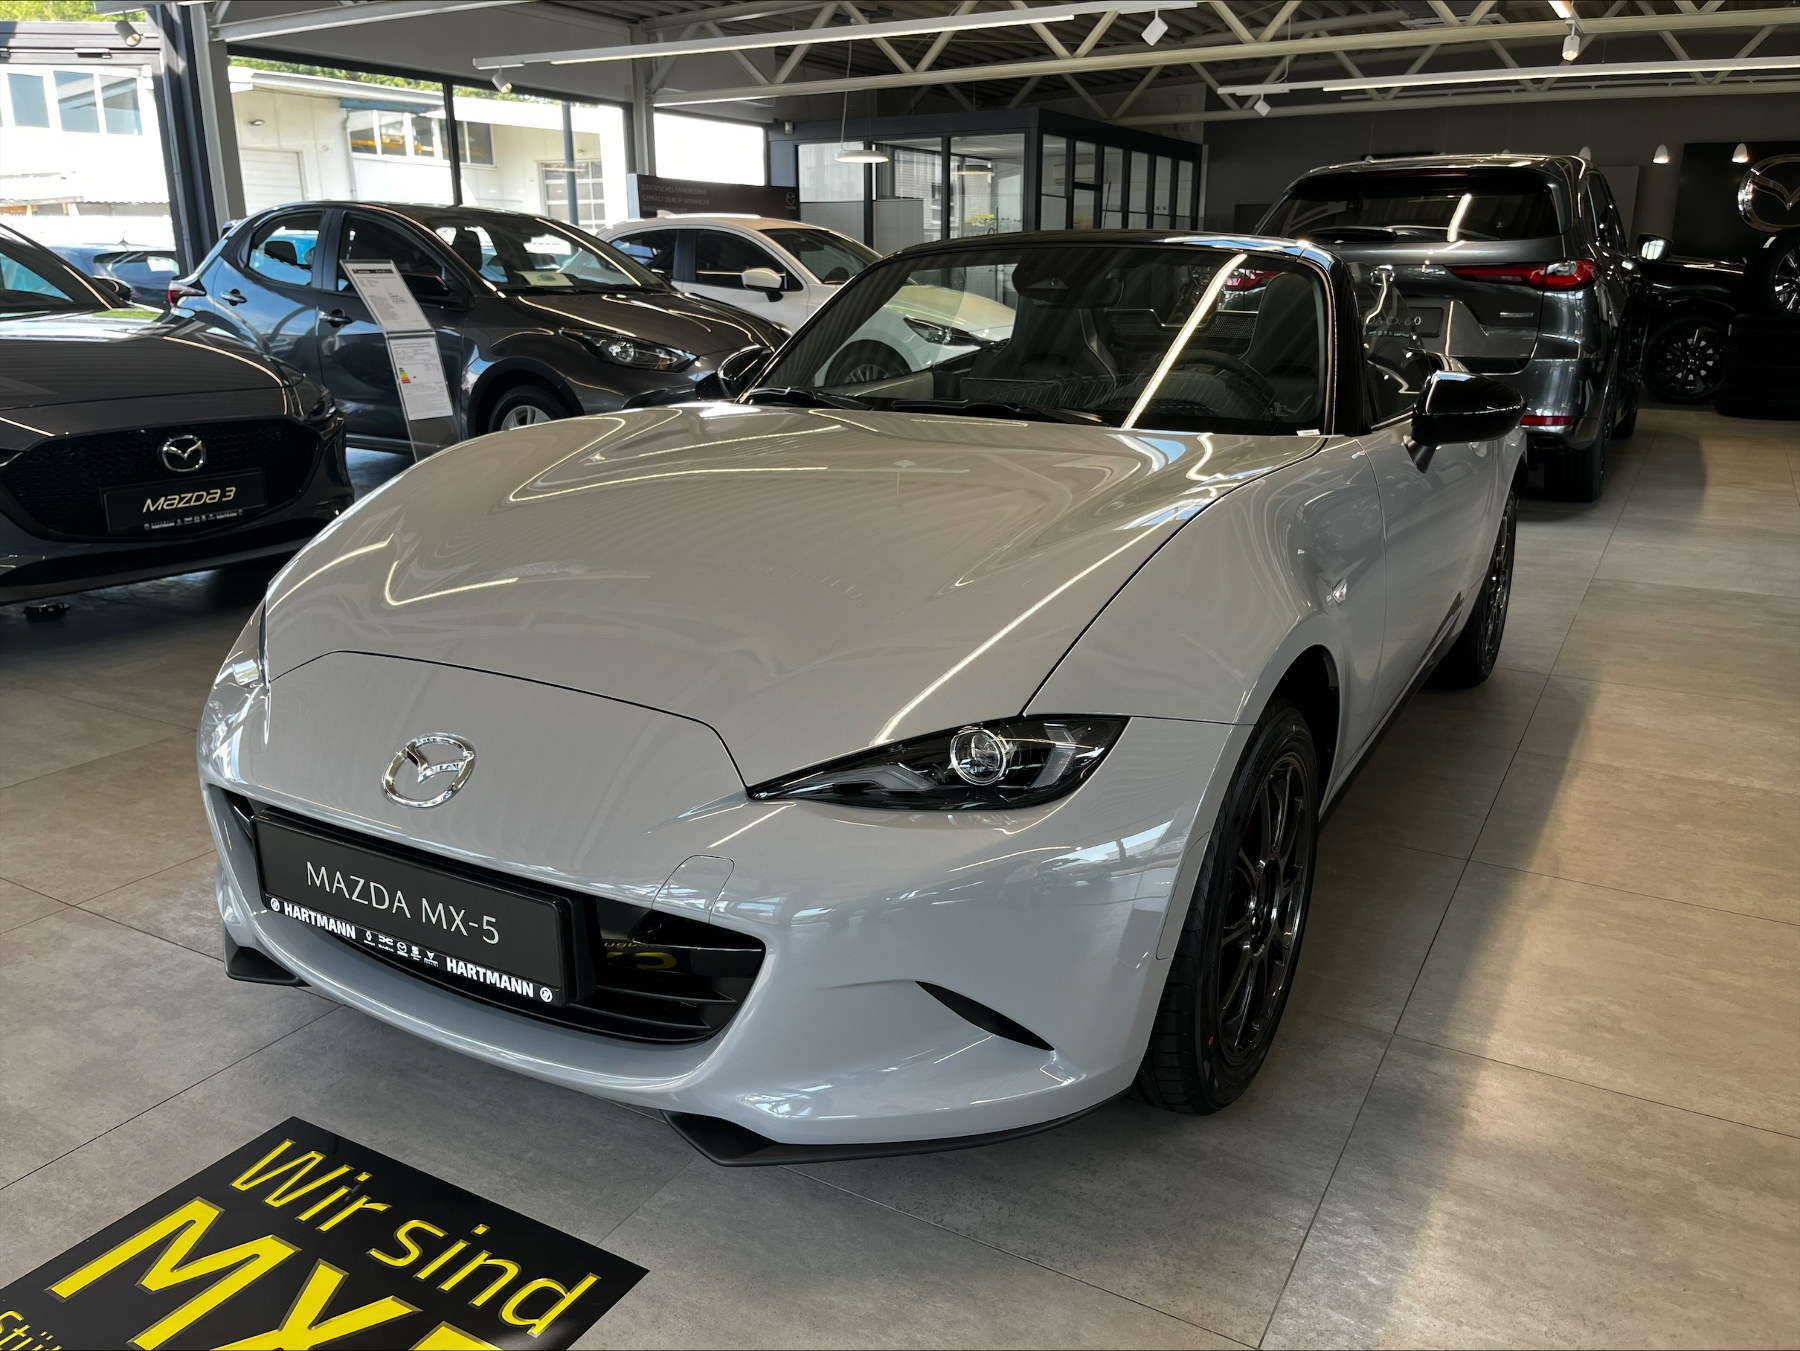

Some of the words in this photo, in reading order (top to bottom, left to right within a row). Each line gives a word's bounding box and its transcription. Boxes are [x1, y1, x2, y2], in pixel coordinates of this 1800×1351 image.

[284, 902, 356, 939] HARTMANN
[446, 957, 534, 998] HARTMANN
[306, 861, 411, 918] MAZDA
[422, 897, 499, 944] MX-5
[44, 1196, 502, 1350] MX
[231, 1139, 391, 1232] Wir
[366, 1219, 601, 1338] sind
